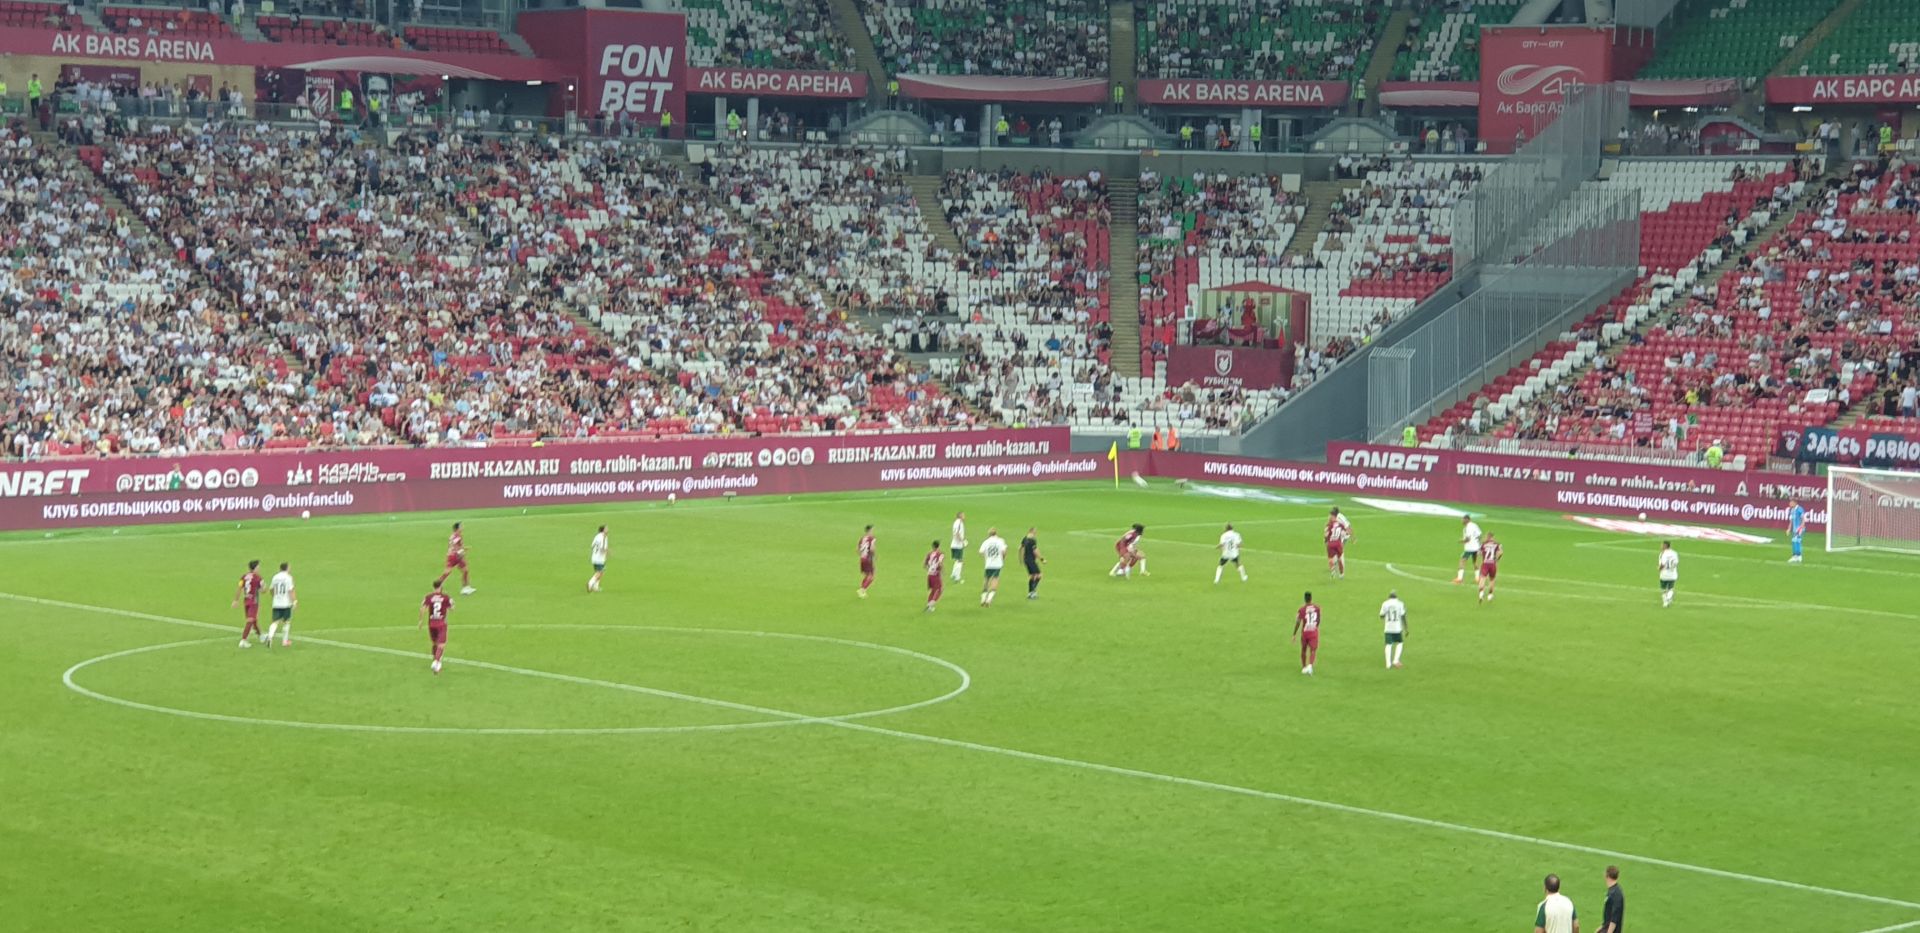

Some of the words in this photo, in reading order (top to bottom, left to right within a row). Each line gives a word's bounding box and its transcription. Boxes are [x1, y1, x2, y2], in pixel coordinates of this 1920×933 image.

[52, 33, 80, 53] AK
[86, 35, 141, 57] BARS
[145, 38, 215, 61] ARENA
[600, 44, 673, 78] FON
[700, 71, 726, 89] АК
[731, 72, 782, 91] БАРС
[786, 74, 852, 94] АРЕНА
[1163, 83, 1191, 100] AK
[1196, 83, 1250, 101] BARS
[1254, 84, 1324, 103] ARENA
[1813, 80, 1839, 98] АК
[1844, 79, 1895, 98] БАРС
[600, 79, 673, 113] BET
[1497, 101, 1513, 114] Ак
[828, 443, 937, 464] RUBIN-KAZAN.RU
[945, 440, 1050, 459] store.rubin-kazan.ru
[1806, 432, 1861, 457] ЗДЕСЬ
[430, 458, 560, 480] RUBIN-KAZAN.RU
[570, 454, 692, 475] store.rubin-kazan.ru
[881, 467, 906, 481] КЛУБ
[907, 464, 976, 481] БОЛЕЛЬЩИКОВ
[977, 463, 992, 477] ФК
[993, 463, 1031, 477] «РУБИН»
[1032, 458, 1097, 477] @rubinfanclub
[1204, 461, 1228, 475] КЛУБ
[1229, 463, 1298, 481] БОЛЕЛЬЩИКОВ
[1299, 469, 1314, 483] ФК
[1314, 470, 1356, 486] «РУБИН»
[1356, 473, 1429, 493] @rubinfanclub
[116, 473, 176, 493] @FCR
[503, 484, 533, 499] КЛУБ
[534, 480, 617, 498] БОЛЕЛЬЩИКОВ
[617, 479, 635, 493] ФК
[636, 477, 681, 493] «РУБИН»
[682, 473, 758, 493] @rubinfanclub
[43, 504, 78, 519] КЛУБ
[80, 500, 181, 519] БОЛЕЛЬЩИКОВ
[182, 498, 202, 513] ФК
[205, 495, 259, 512] «РУБИН»
[261, 490, 354, 512] @rubinfanclub
[1557, 490, 1586, 505] КЛУБ
[1587, 491, 1670, 512] БОЛЕЛЬЩИКОВ
[1670, 499, 1688, 514] ФК
[1690, 500, 1740, 517] «РУБИН»
[432, 601, 443, 618] 2
[1304, 611, 1318, 626] 12
[1386, 609, 1399, 622] 11
